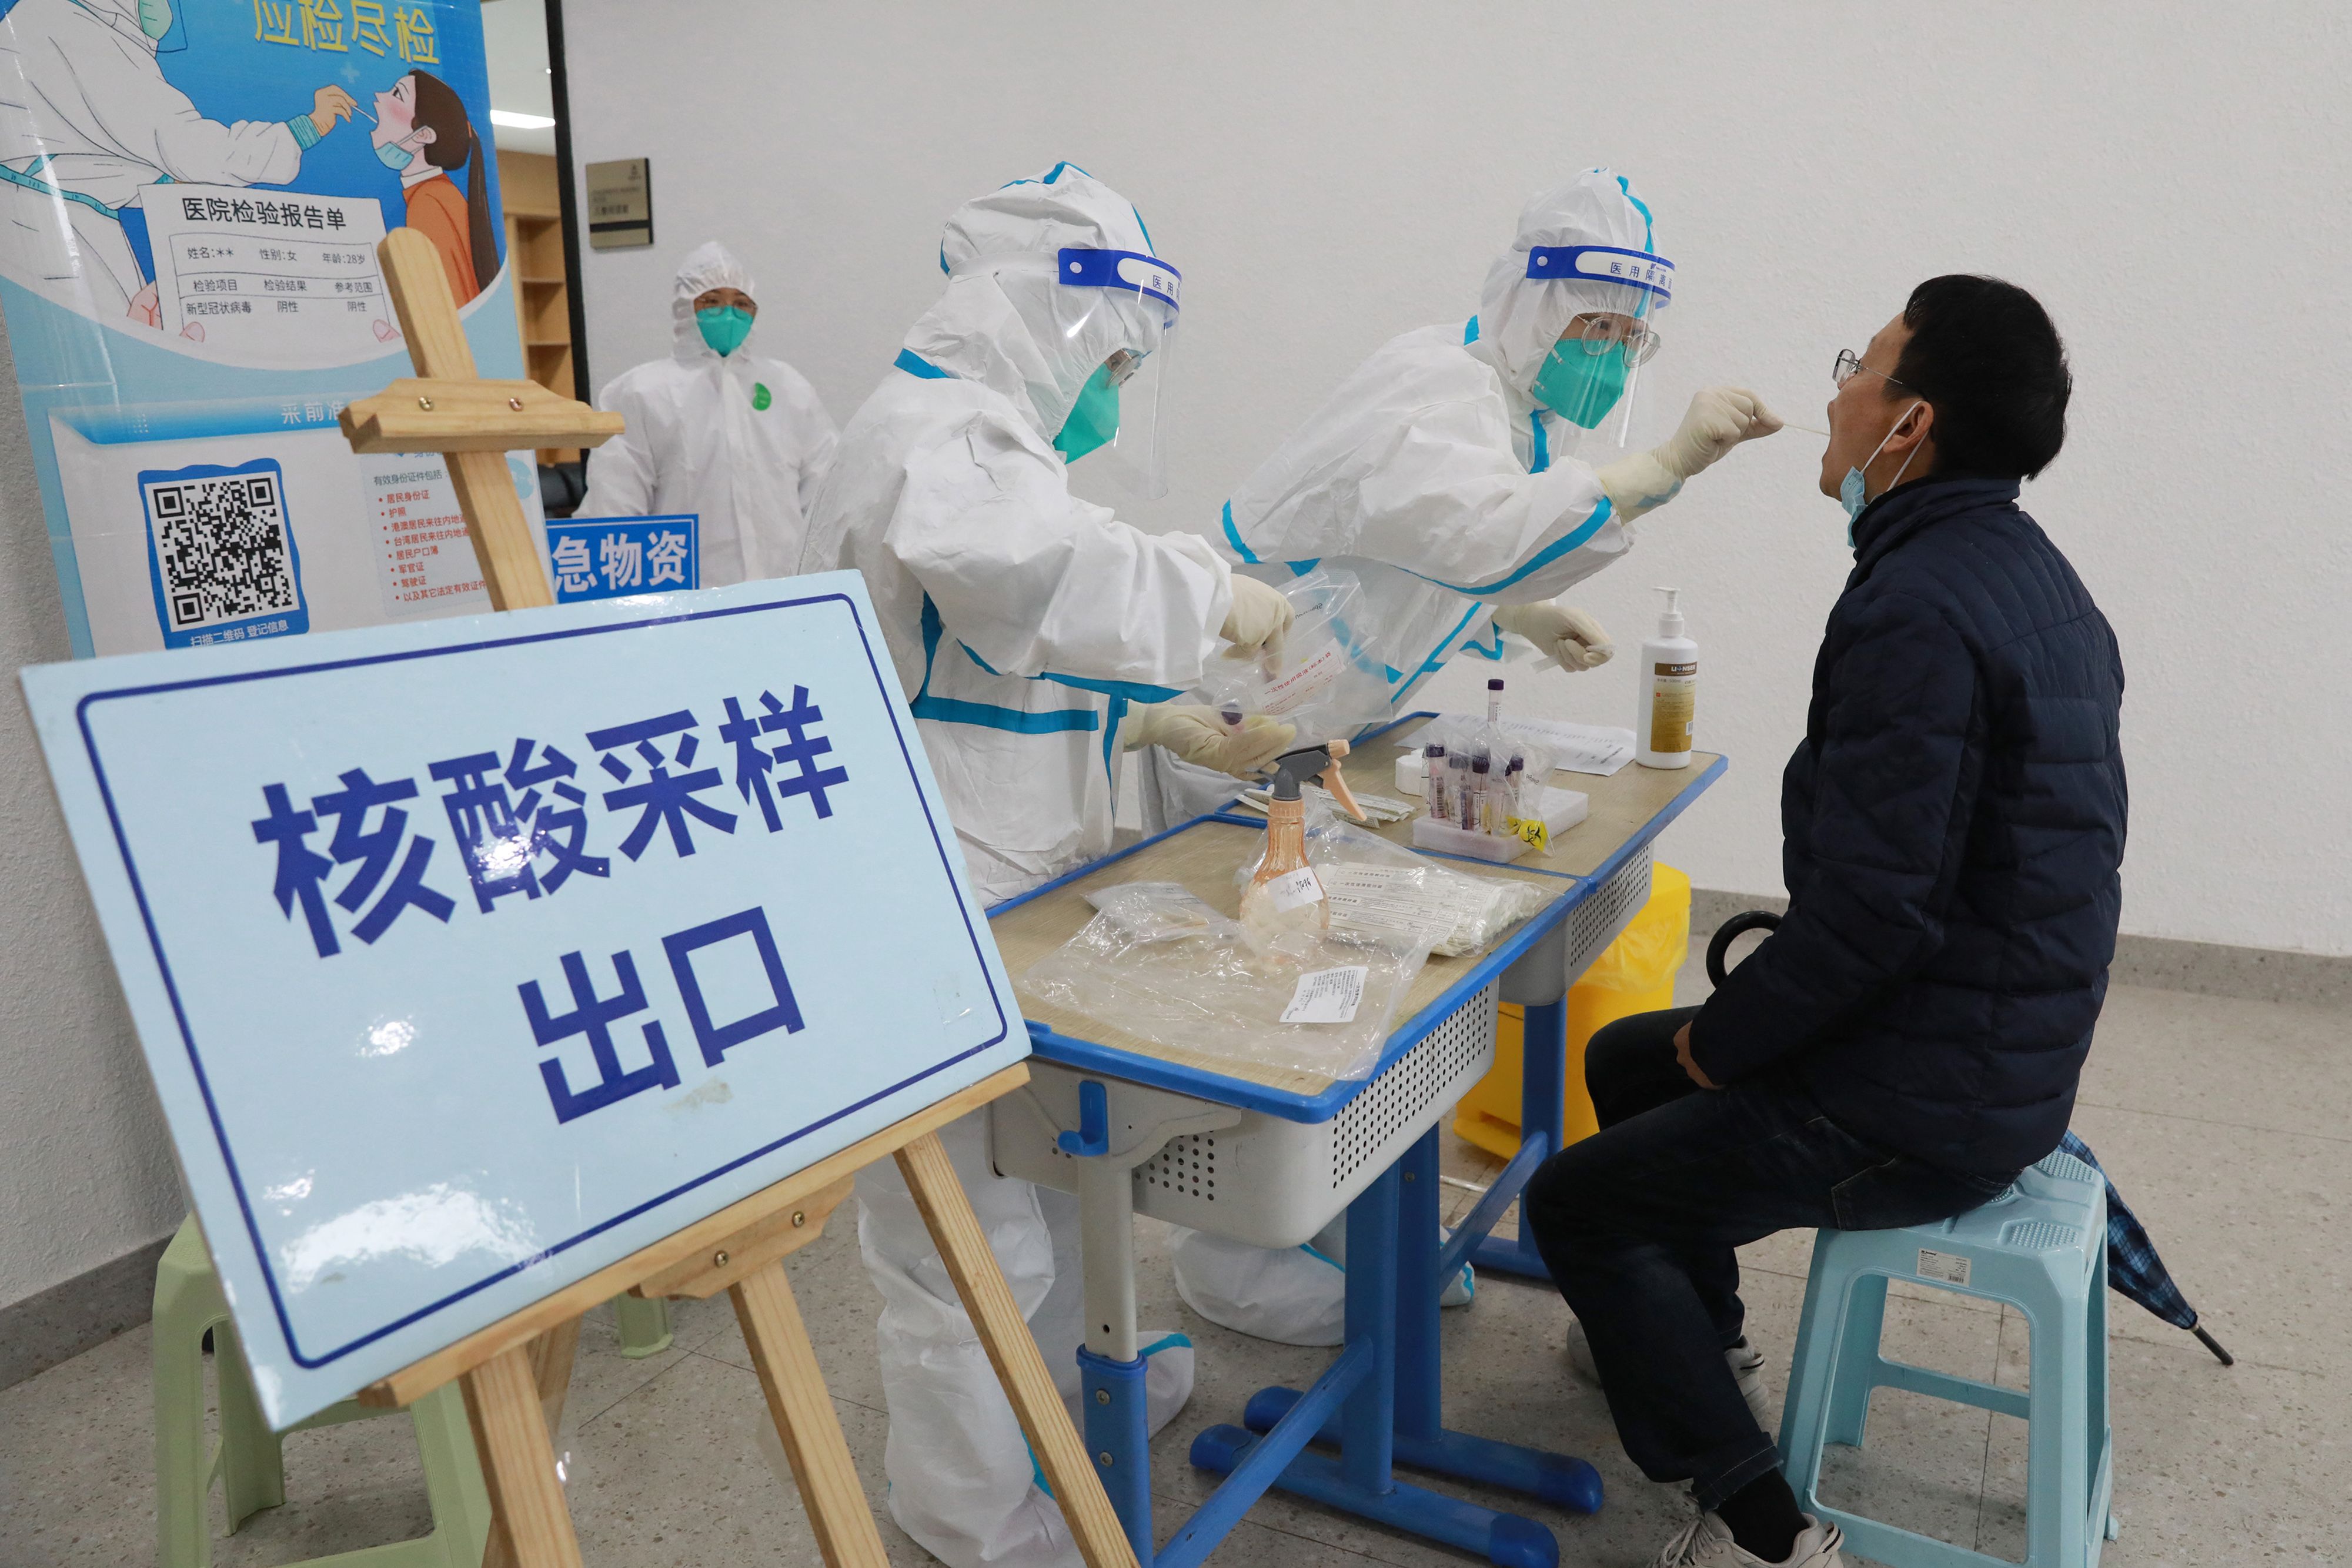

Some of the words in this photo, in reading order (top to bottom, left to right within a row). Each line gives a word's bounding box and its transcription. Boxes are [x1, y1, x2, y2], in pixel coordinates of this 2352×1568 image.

[255, 0, 440, 64] 应检尽检
[182, 198, 346, 230] 医院检验报告单
[193, 279, 238, 292] 检验项目
[264, 280, 307, 292] 检验结果
[335, 282, 373, 293] 参考范围
[186, 302, 252, 315] 新型冠状病毒
[277, 301, 299, 313] 阴性
[348, 301, 367, 312] 阴性
[386, 490, 430, 504] 居民身份证
[389, 507, 406, 518] 护照
[398, 561, 425, 574] 军官证
[552, 530, 688, 593] 急物资
[191, 628, 245, 647] 扫描二维码
[247, 620, 289, 638] 登记信息
[250, 684, 850, 959] 核酸采样
[517, 905, 806, 1125] 出口
